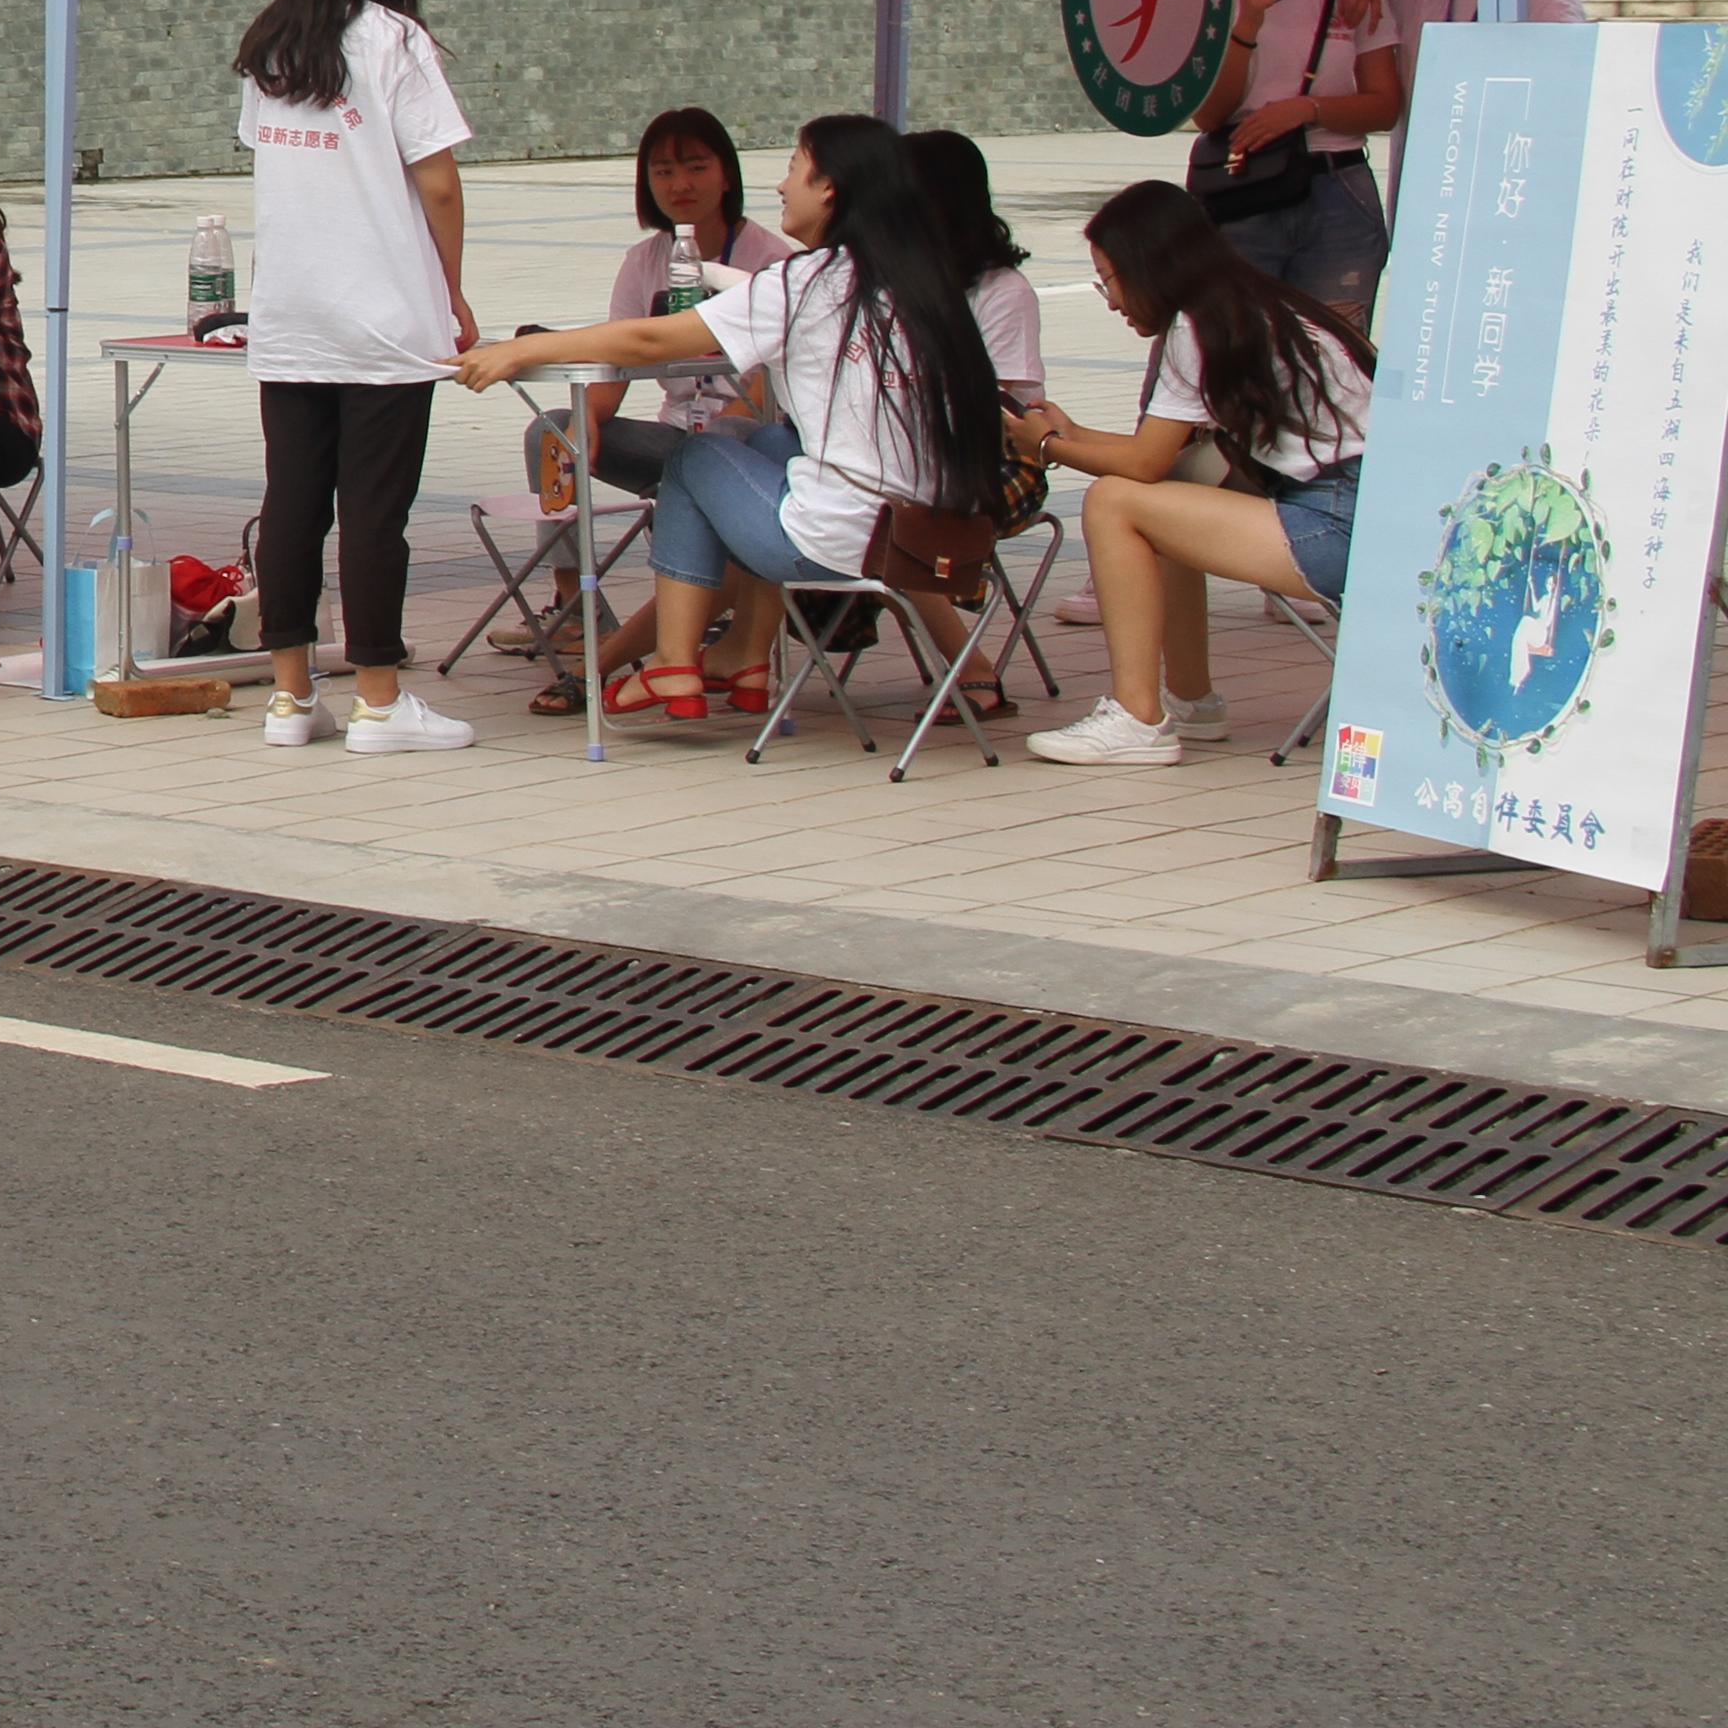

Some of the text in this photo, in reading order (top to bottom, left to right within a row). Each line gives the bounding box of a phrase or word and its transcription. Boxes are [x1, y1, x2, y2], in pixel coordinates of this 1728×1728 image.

[257, 124, 341, 151] 迎新志愿者
[1411, 80, 1469, 402] WELCOME NEW STUDENTS
[1414, 777, 1606, 851] 公寓自律委員會
